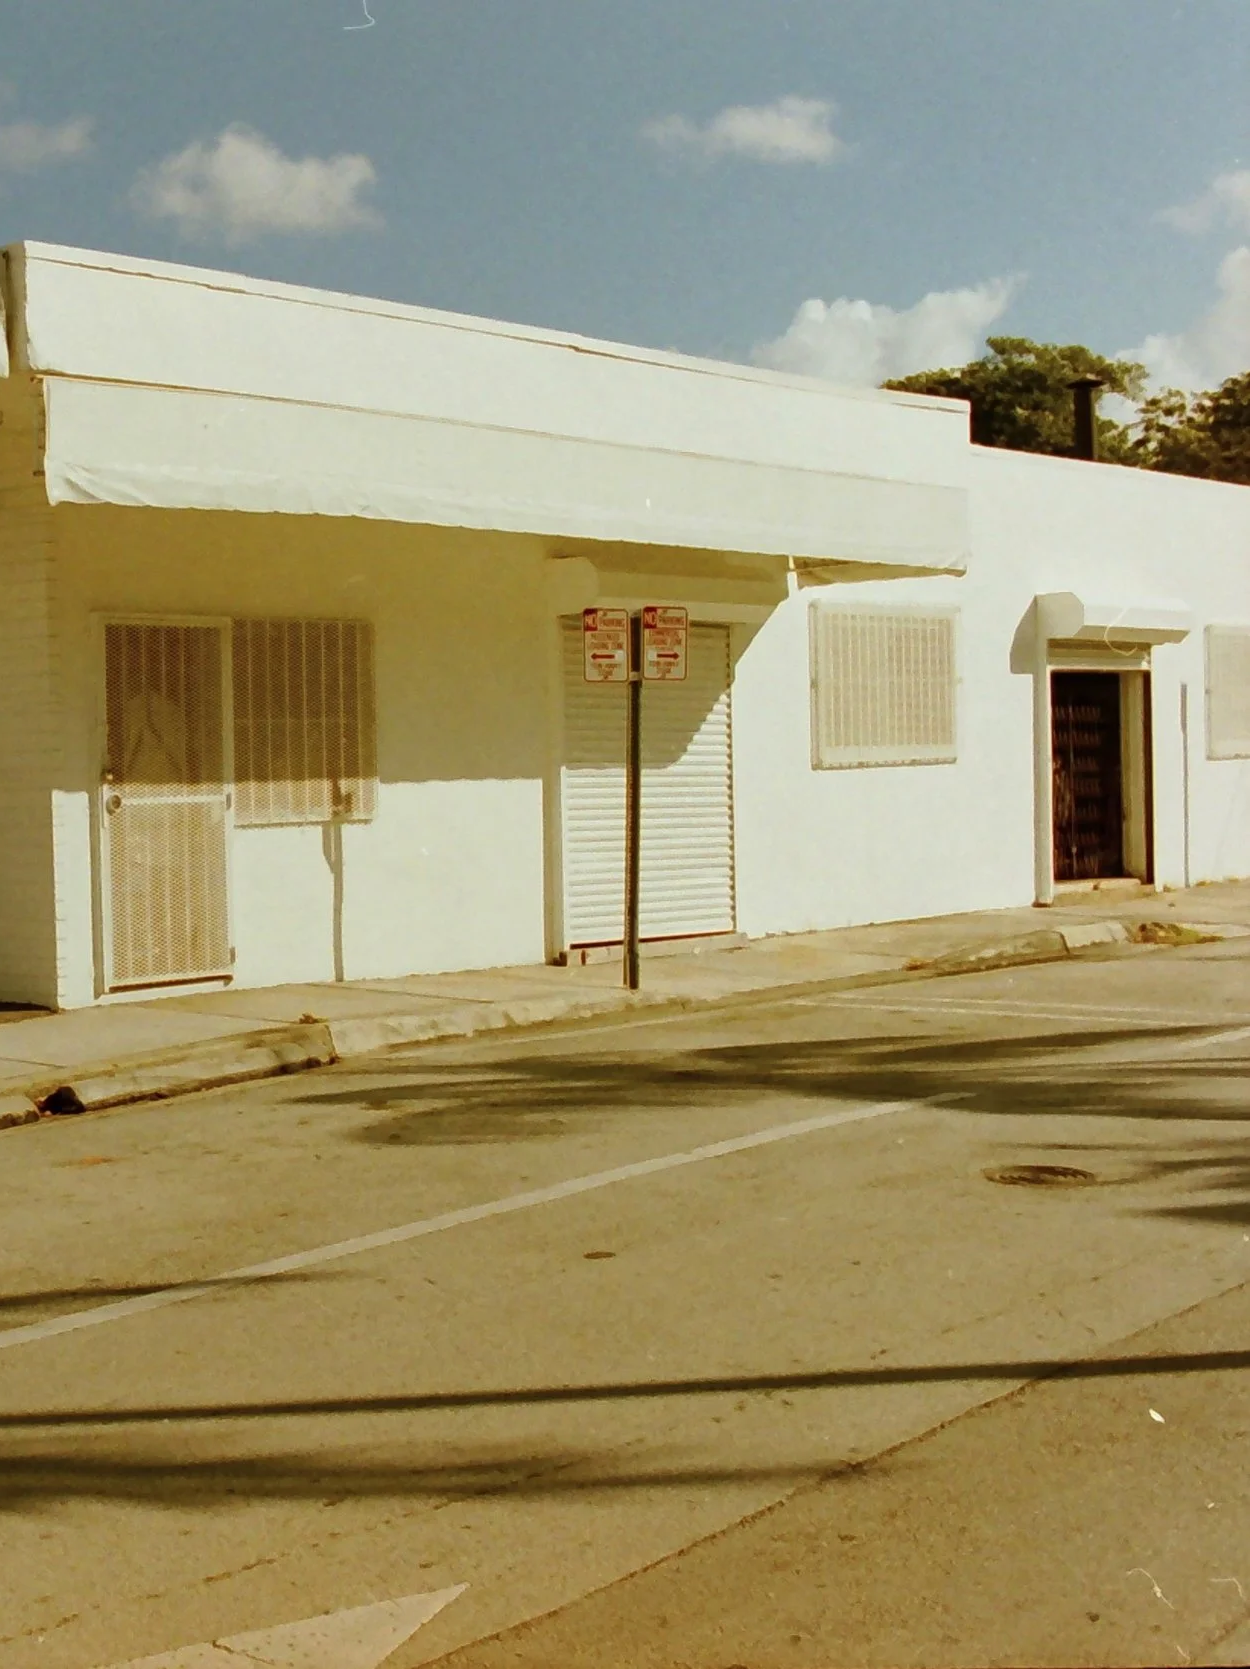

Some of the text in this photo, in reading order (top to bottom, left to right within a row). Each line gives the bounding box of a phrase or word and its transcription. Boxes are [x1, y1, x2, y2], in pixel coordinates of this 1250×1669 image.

[585, 614, 625, 627] NO PARKING
[644, 612, 684, 626] NO PARKING
